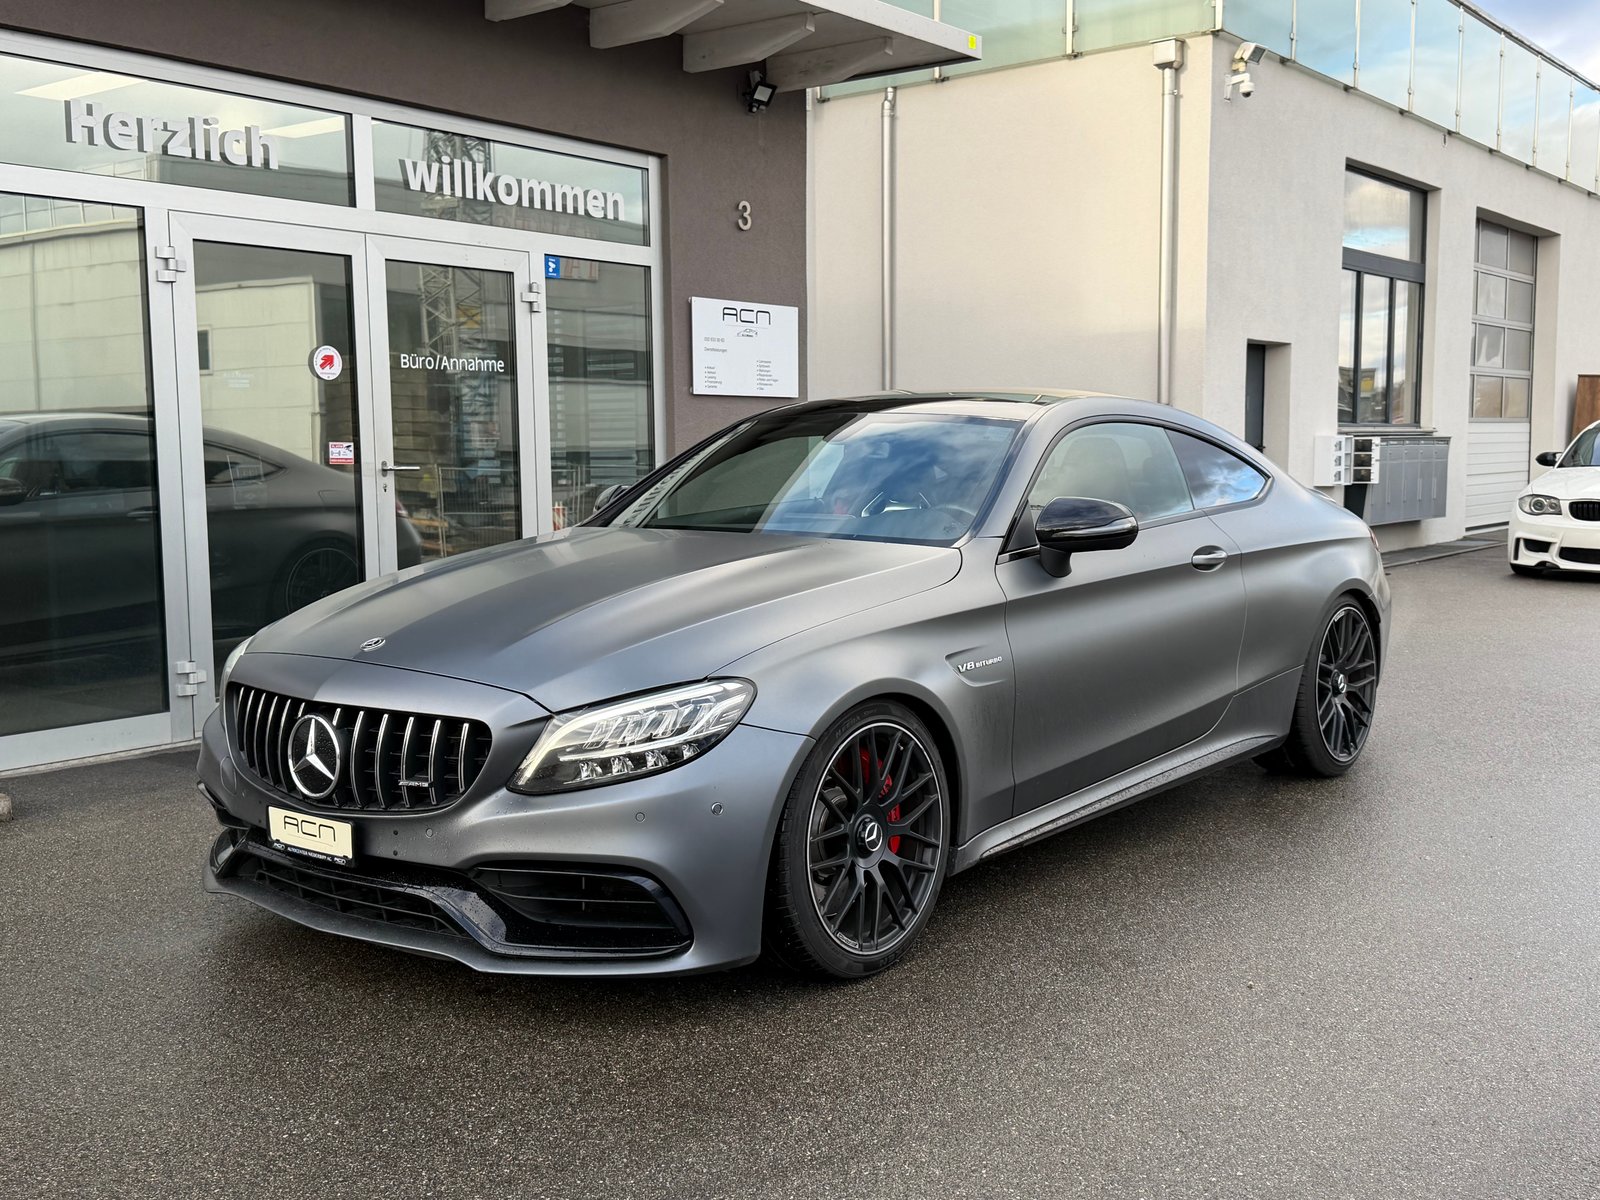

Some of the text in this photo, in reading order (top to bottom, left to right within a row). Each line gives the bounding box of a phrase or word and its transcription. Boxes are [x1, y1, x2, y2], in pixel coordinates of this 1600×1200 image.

[66, 99, 279, 170] Herzlich
[738, 200, 752, 231] 3
[400, 353, 505, 373] Büro/Annahme
[957, 656, 1003, 673] V8 BITURBO
